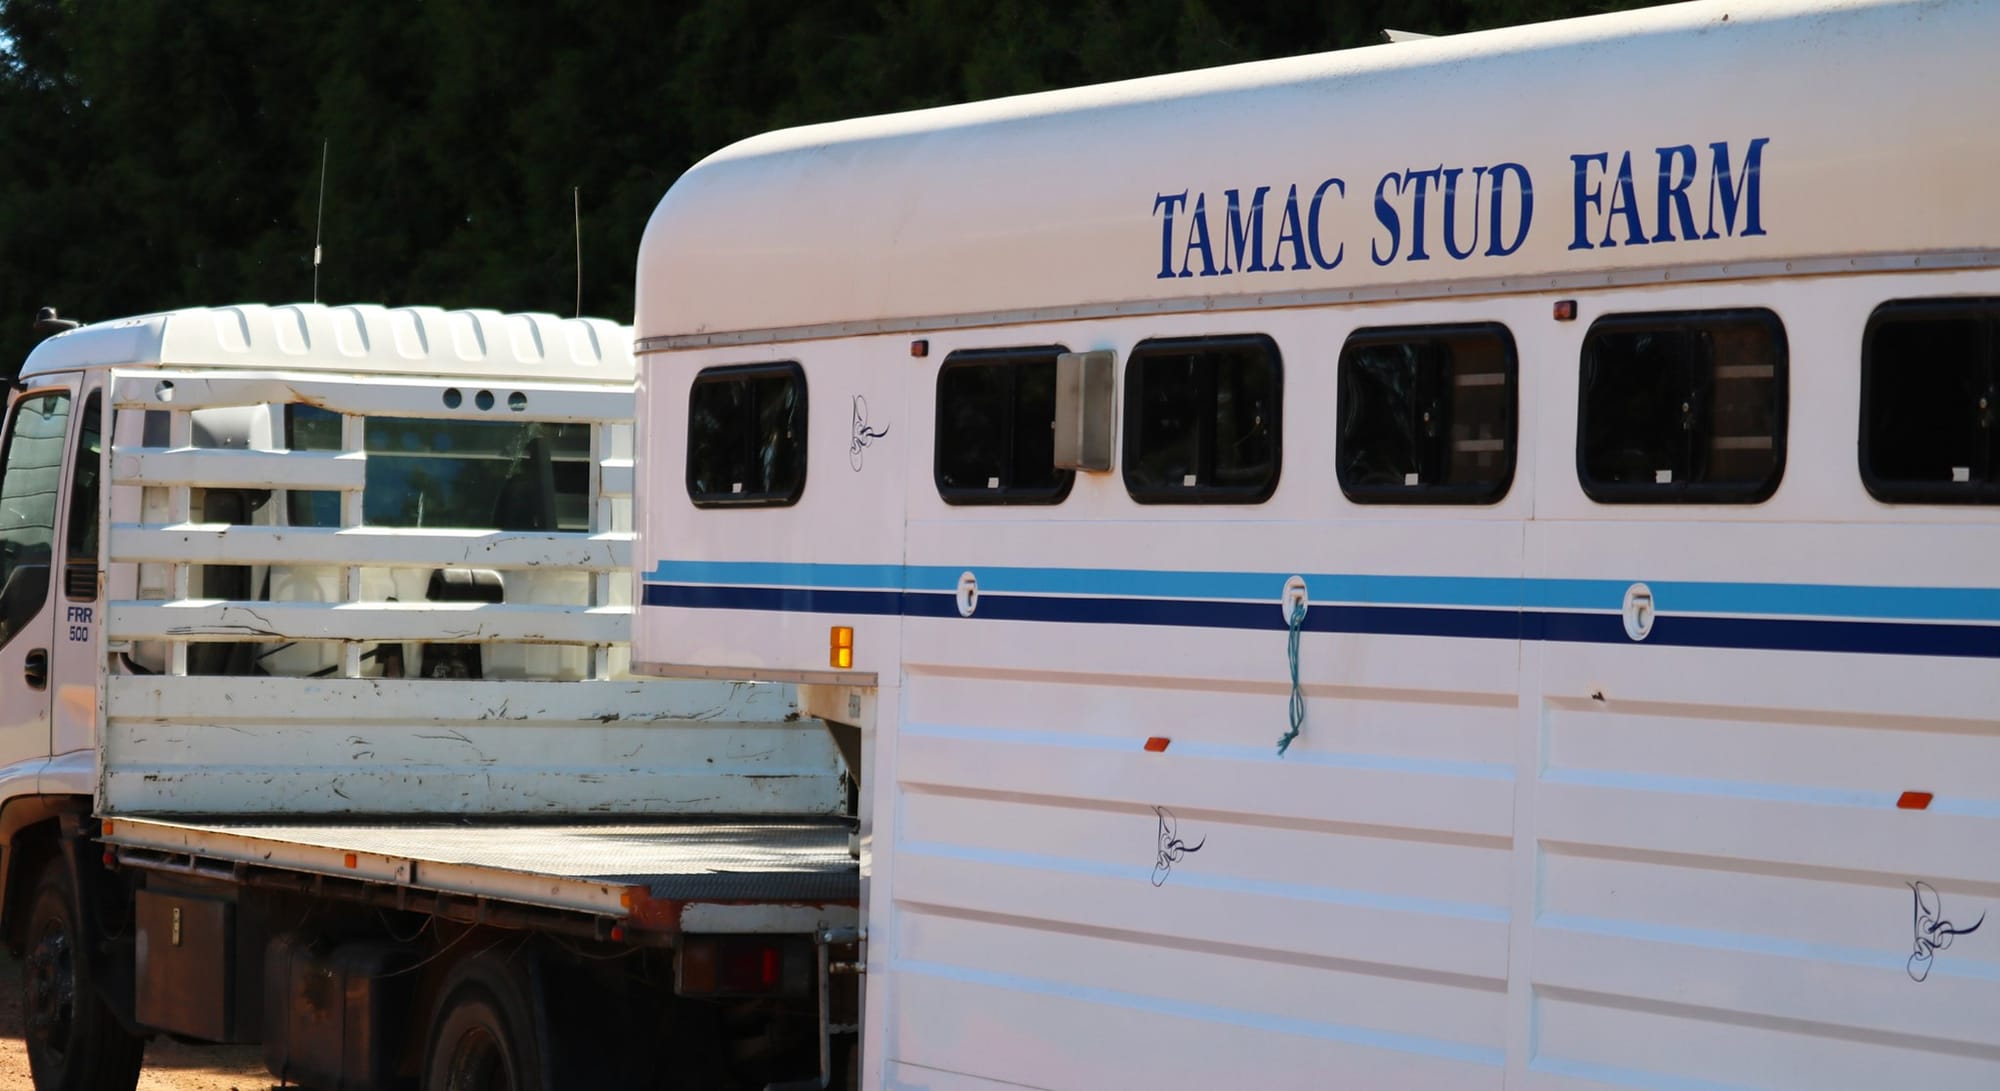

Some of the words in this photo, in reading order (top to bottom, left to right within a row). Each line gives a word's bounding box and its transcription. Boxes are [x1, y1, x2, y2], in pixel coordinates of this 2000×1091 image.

[1153, 178, 1346, 280] TAMAC
[1371, 162, 1534, 266] STUD
[1568, 137, 1770, 250] FARM
[67, 606, 93, 623] FRR
[69, 625, 88, 642] 500
